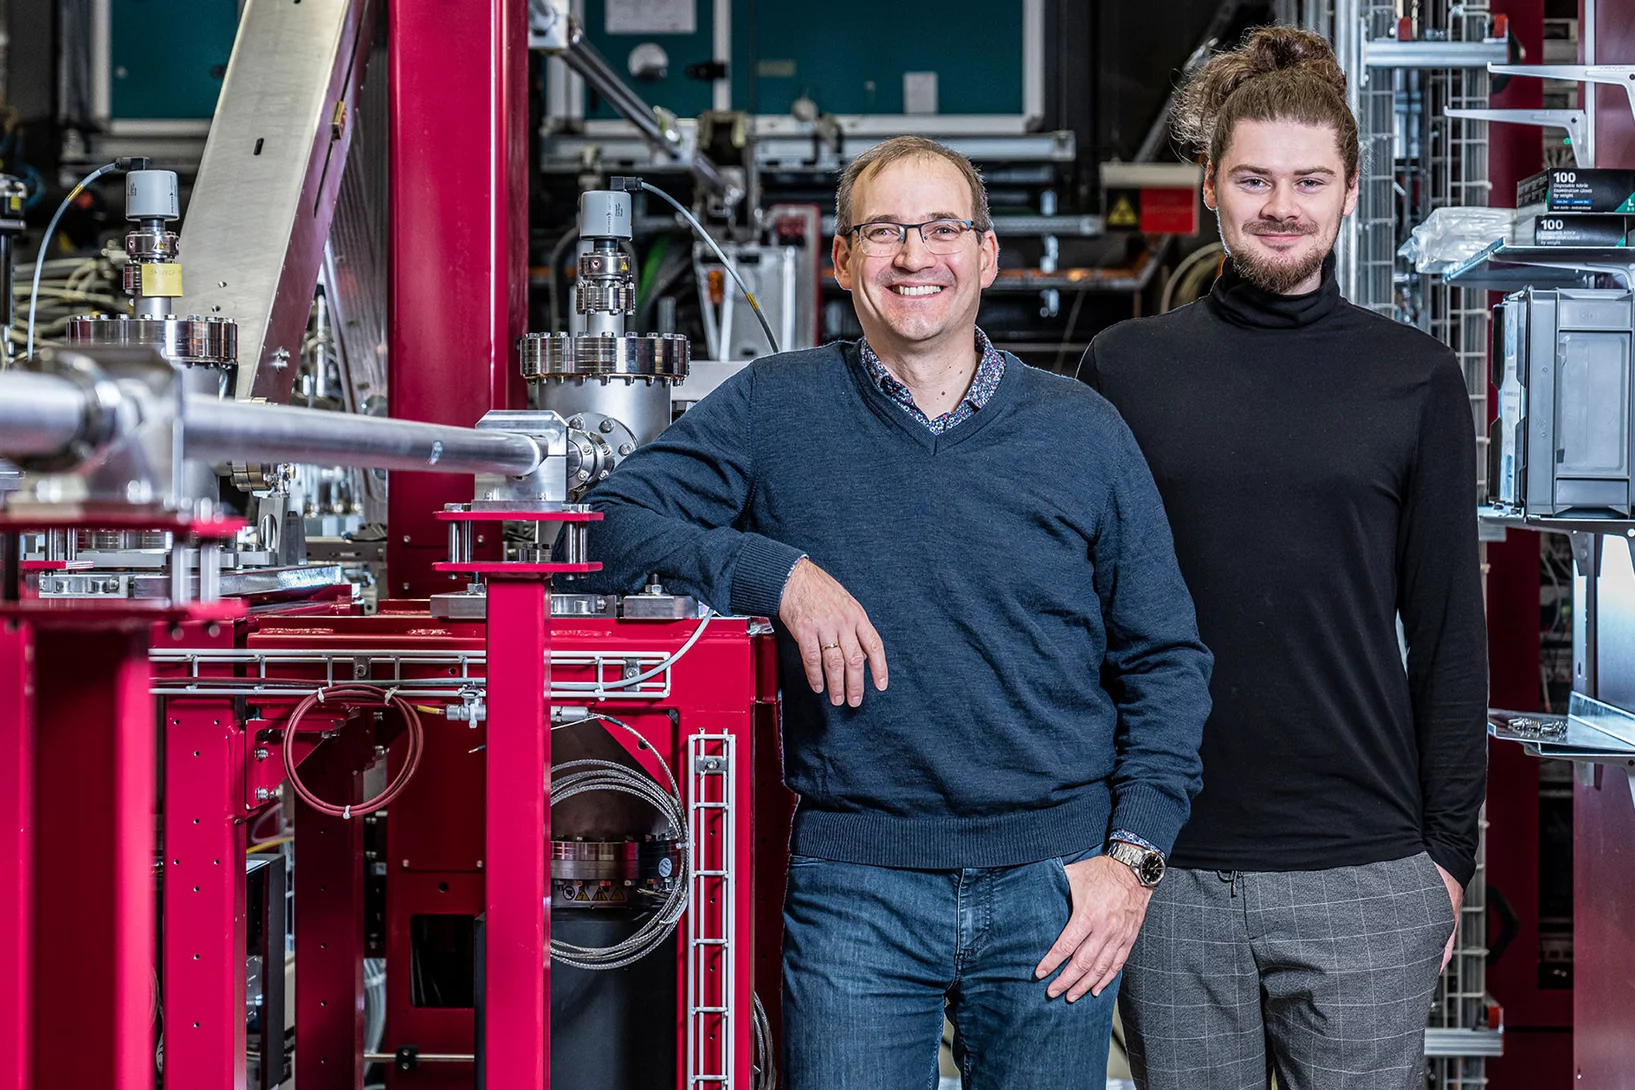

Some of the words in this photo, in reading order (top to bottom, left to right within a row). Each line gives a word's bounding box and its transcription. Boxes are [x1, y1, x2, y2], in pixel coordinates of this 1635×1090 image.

[1553, 172, 1576, 183] 100
[1627, 198, 1634, 206] L
[1540, 219, 1564, 230] 100
